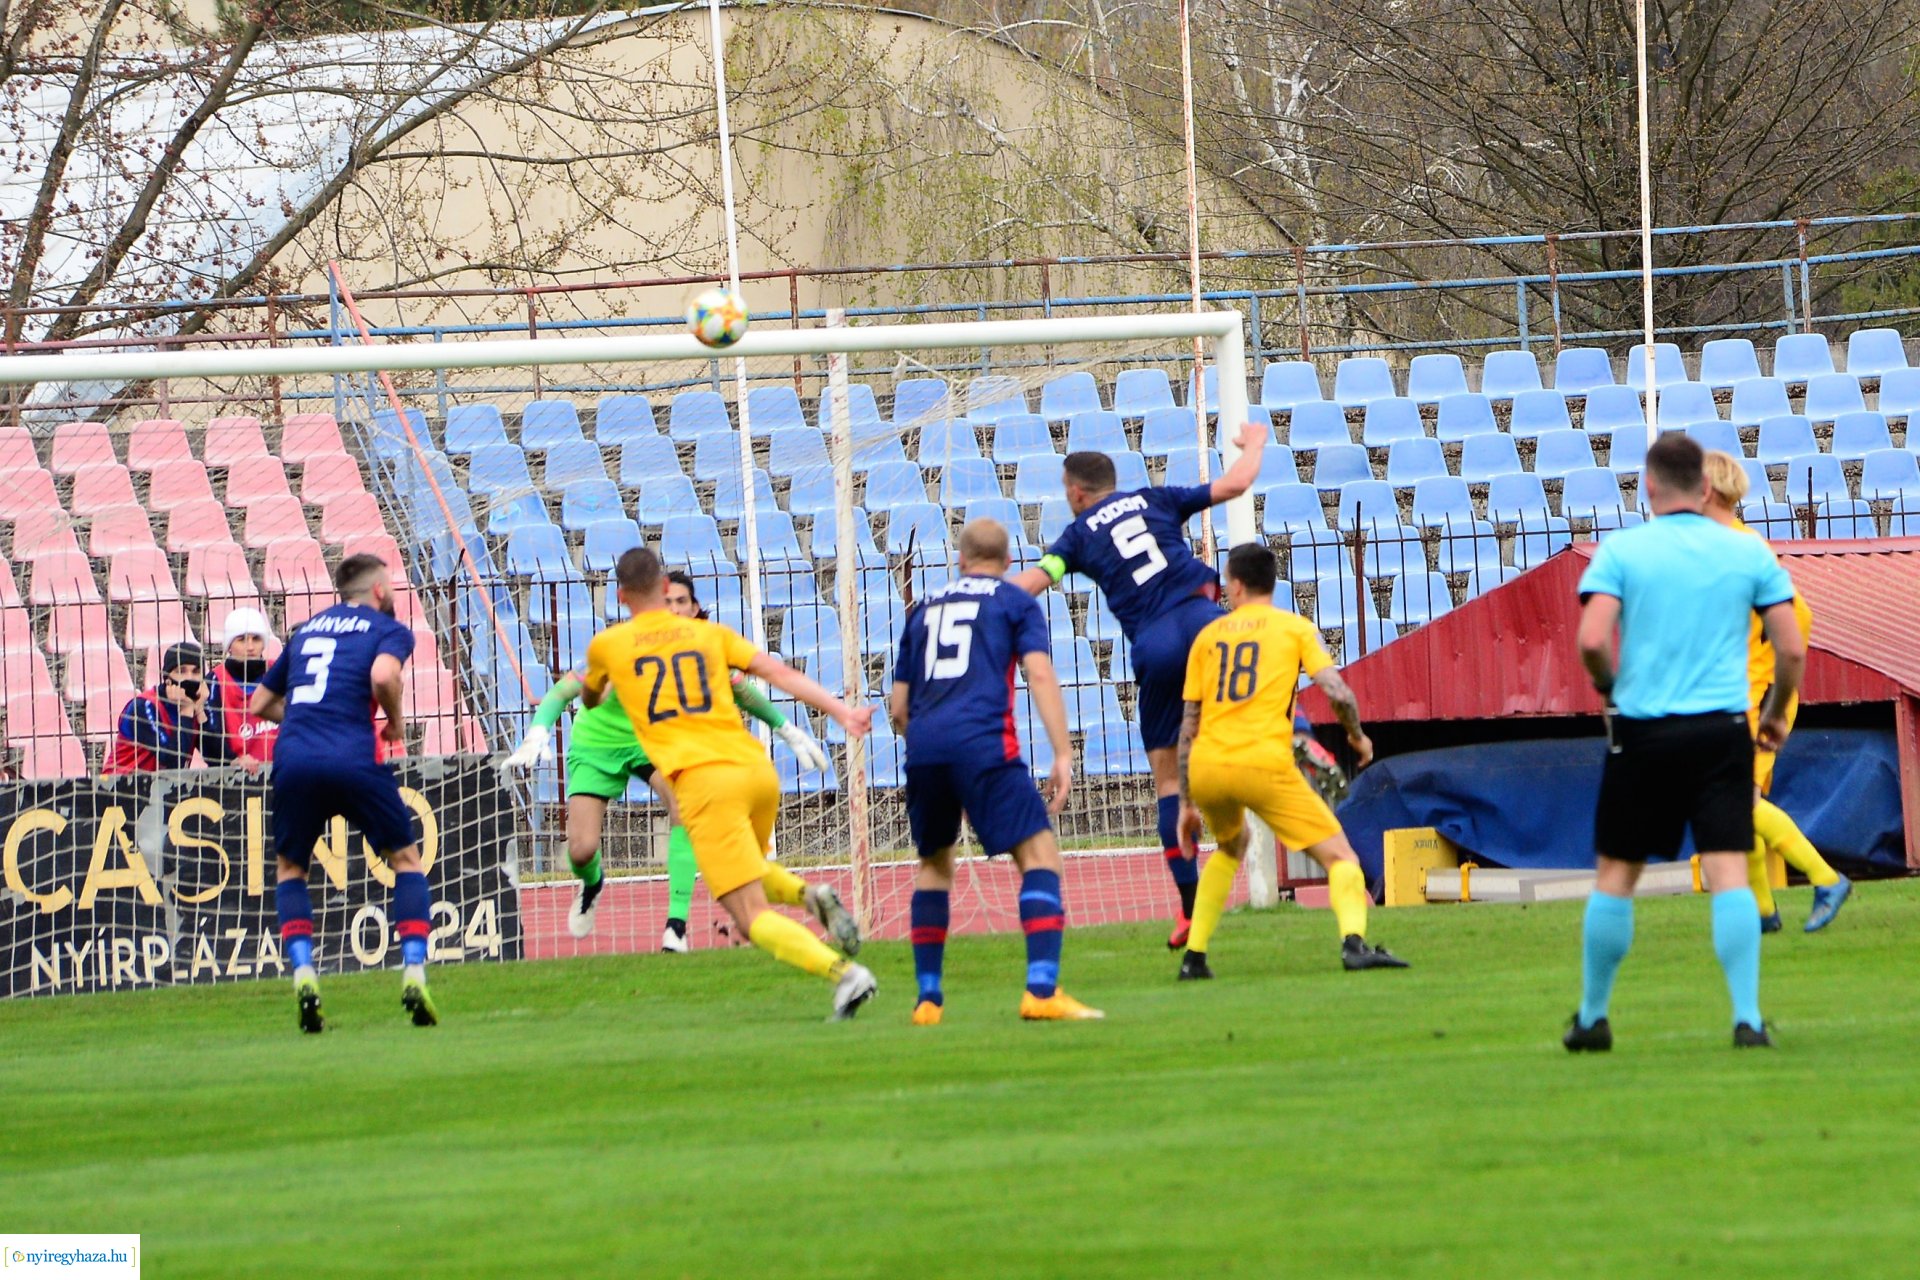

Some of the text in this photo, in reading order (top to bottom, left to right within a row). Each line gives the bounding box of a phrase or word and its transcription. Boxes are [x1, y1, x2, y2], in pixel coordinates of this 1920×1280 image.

[1110, 514, 1168, 586] 5
[291, 637, 337, 705] 3
[923, 602, 980, 682] 15
[1215, 641, 1260, 703] 18
[634, 650, 713, 725] 20
[31, 916, 285, 991] NYÍRPLÁZA
